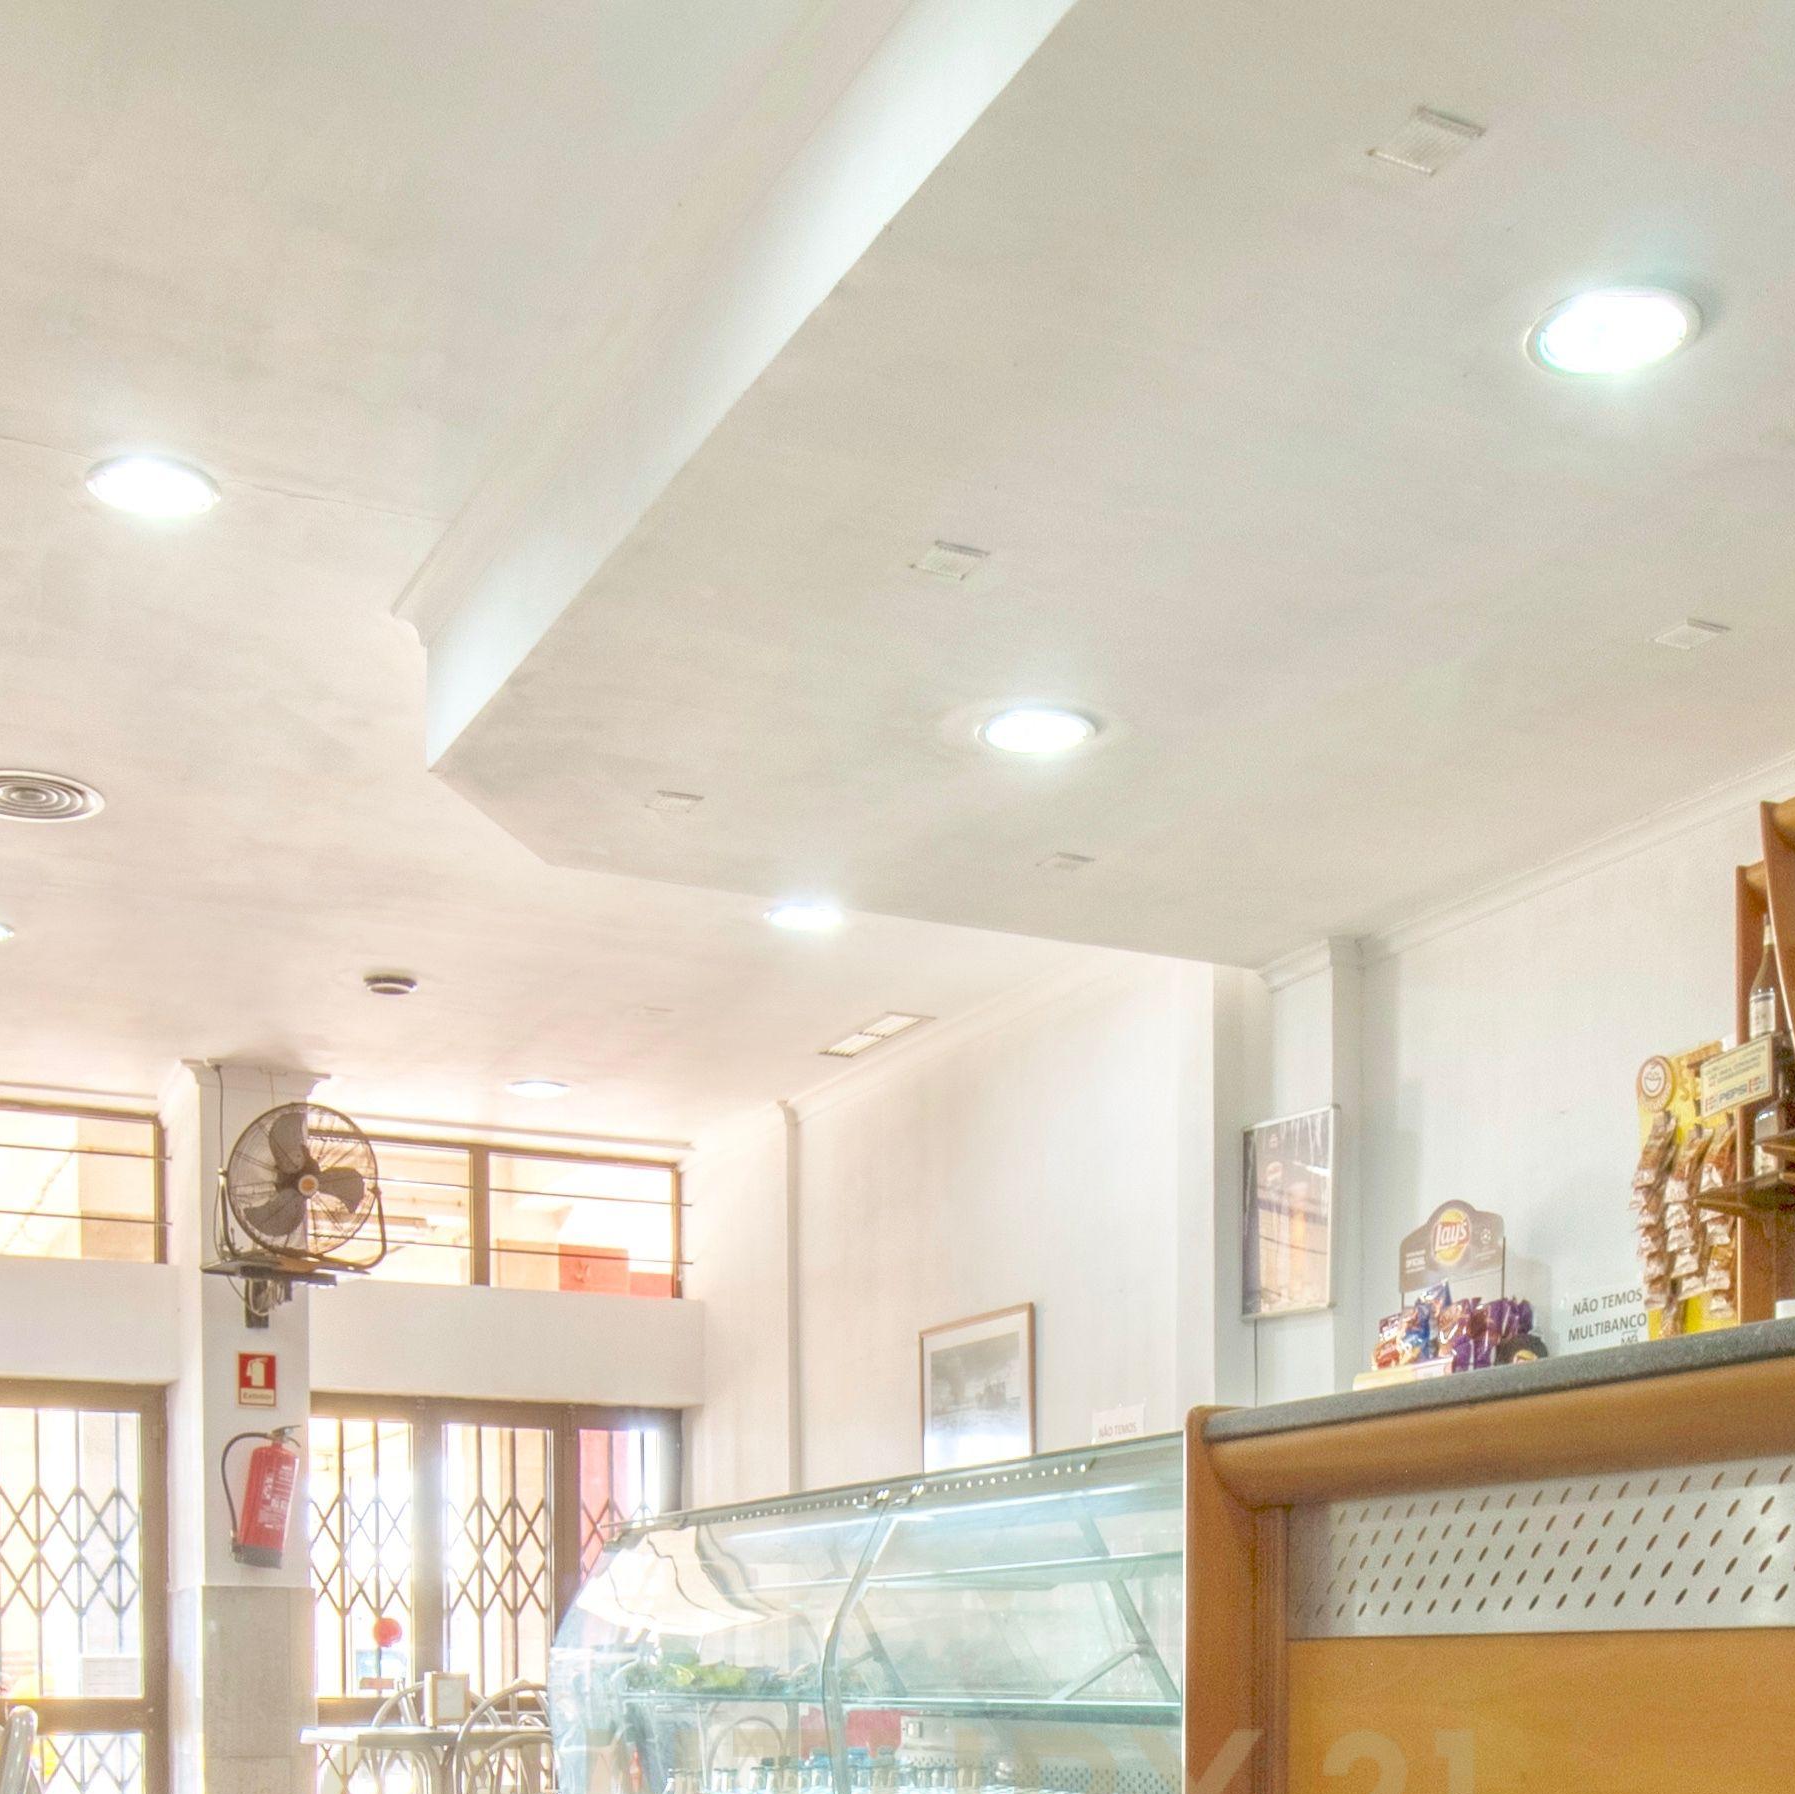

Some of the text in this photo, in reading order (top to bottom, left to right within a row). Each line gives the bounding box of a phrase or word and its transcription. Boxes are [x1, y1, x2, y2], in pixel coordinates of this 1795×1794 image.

[1571, 1287, 1644, 1317] NÃO TEMOS
[1568, 1311, 1648, 1344] MULTIBANCO
